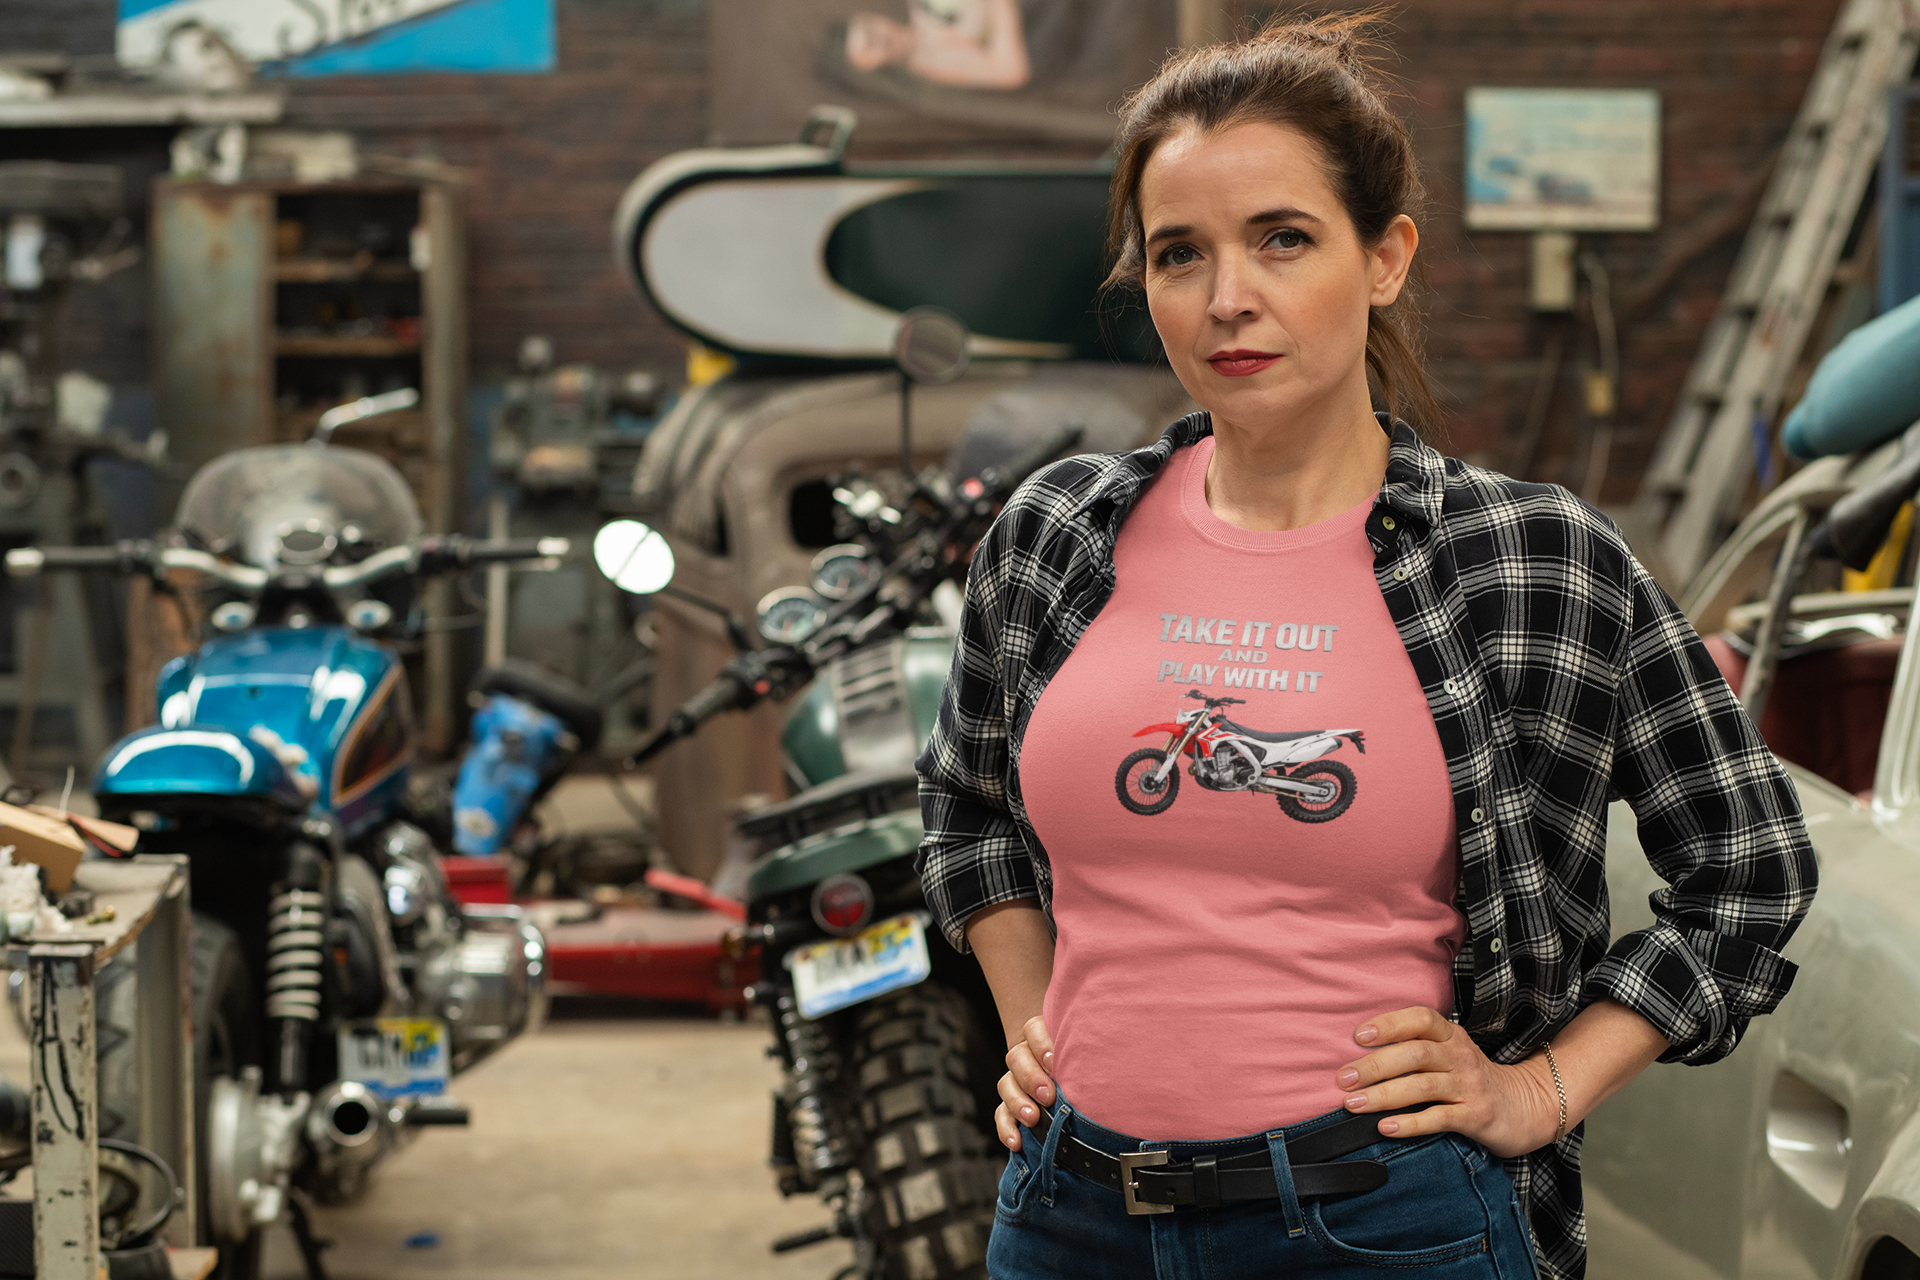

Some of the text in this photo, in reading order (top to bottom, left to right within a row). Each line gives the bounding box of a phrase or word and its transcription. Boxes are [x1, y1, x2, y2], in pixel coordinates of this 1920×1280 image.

[1160, 613, 1338, 652] TAKE IT OUT
[1217, 648, 1268, 664] AND
[1157, 660, 1323, 693] PLAY WITH IT
